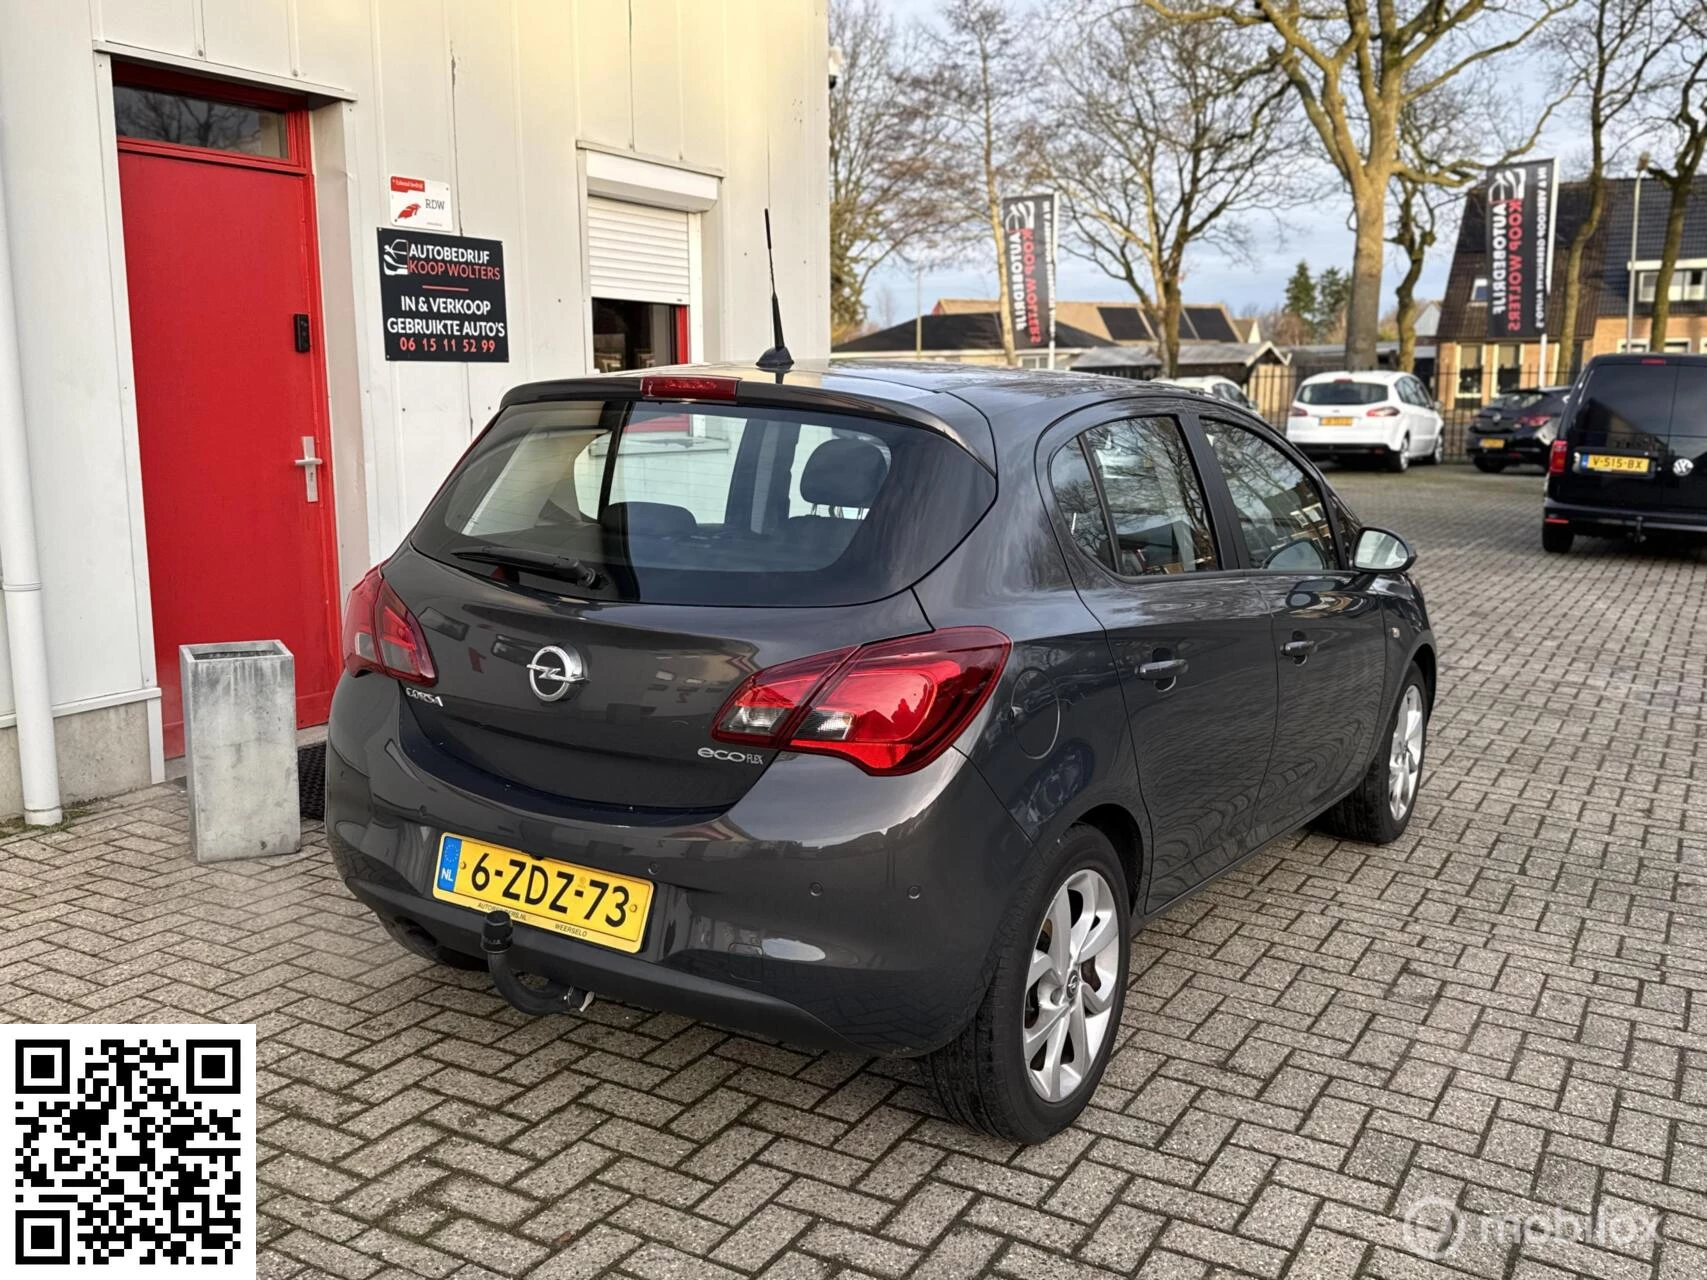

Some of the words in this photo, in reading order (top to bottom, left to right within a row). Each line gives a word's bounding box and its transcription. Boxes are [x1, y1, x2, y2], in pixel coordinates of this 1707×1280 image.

[425, 198, 446, 211] RDW
[409, 243, 490, 264] AUTOBEDRIJF
[409, 260, 446, 275] KOOP
[447, 263, 501, 280] WOLTERS
[401, 295, 417, 312] IN
[418, 296, 429, 312] &
[429, 297, 491, 315] VERKOOP
[387, 317, 461, 336] GEBRUIKTE
[462, 320, 506, 337] AUTO'S
[400, 337, 416, 352] 06
[422, 338, 437, 352] 15
[443, 338, 457, 352] 11
[463, 339, 477, 353] 52
[481, 340, 496, 353] 99
[1592, 456, 1643, 470] V-515-BX
[441, 867, 454, 882] NL
[471, 852, 631, 928] 6-ZDZ-73
[554, 922, 588, 938] WEERSELO
